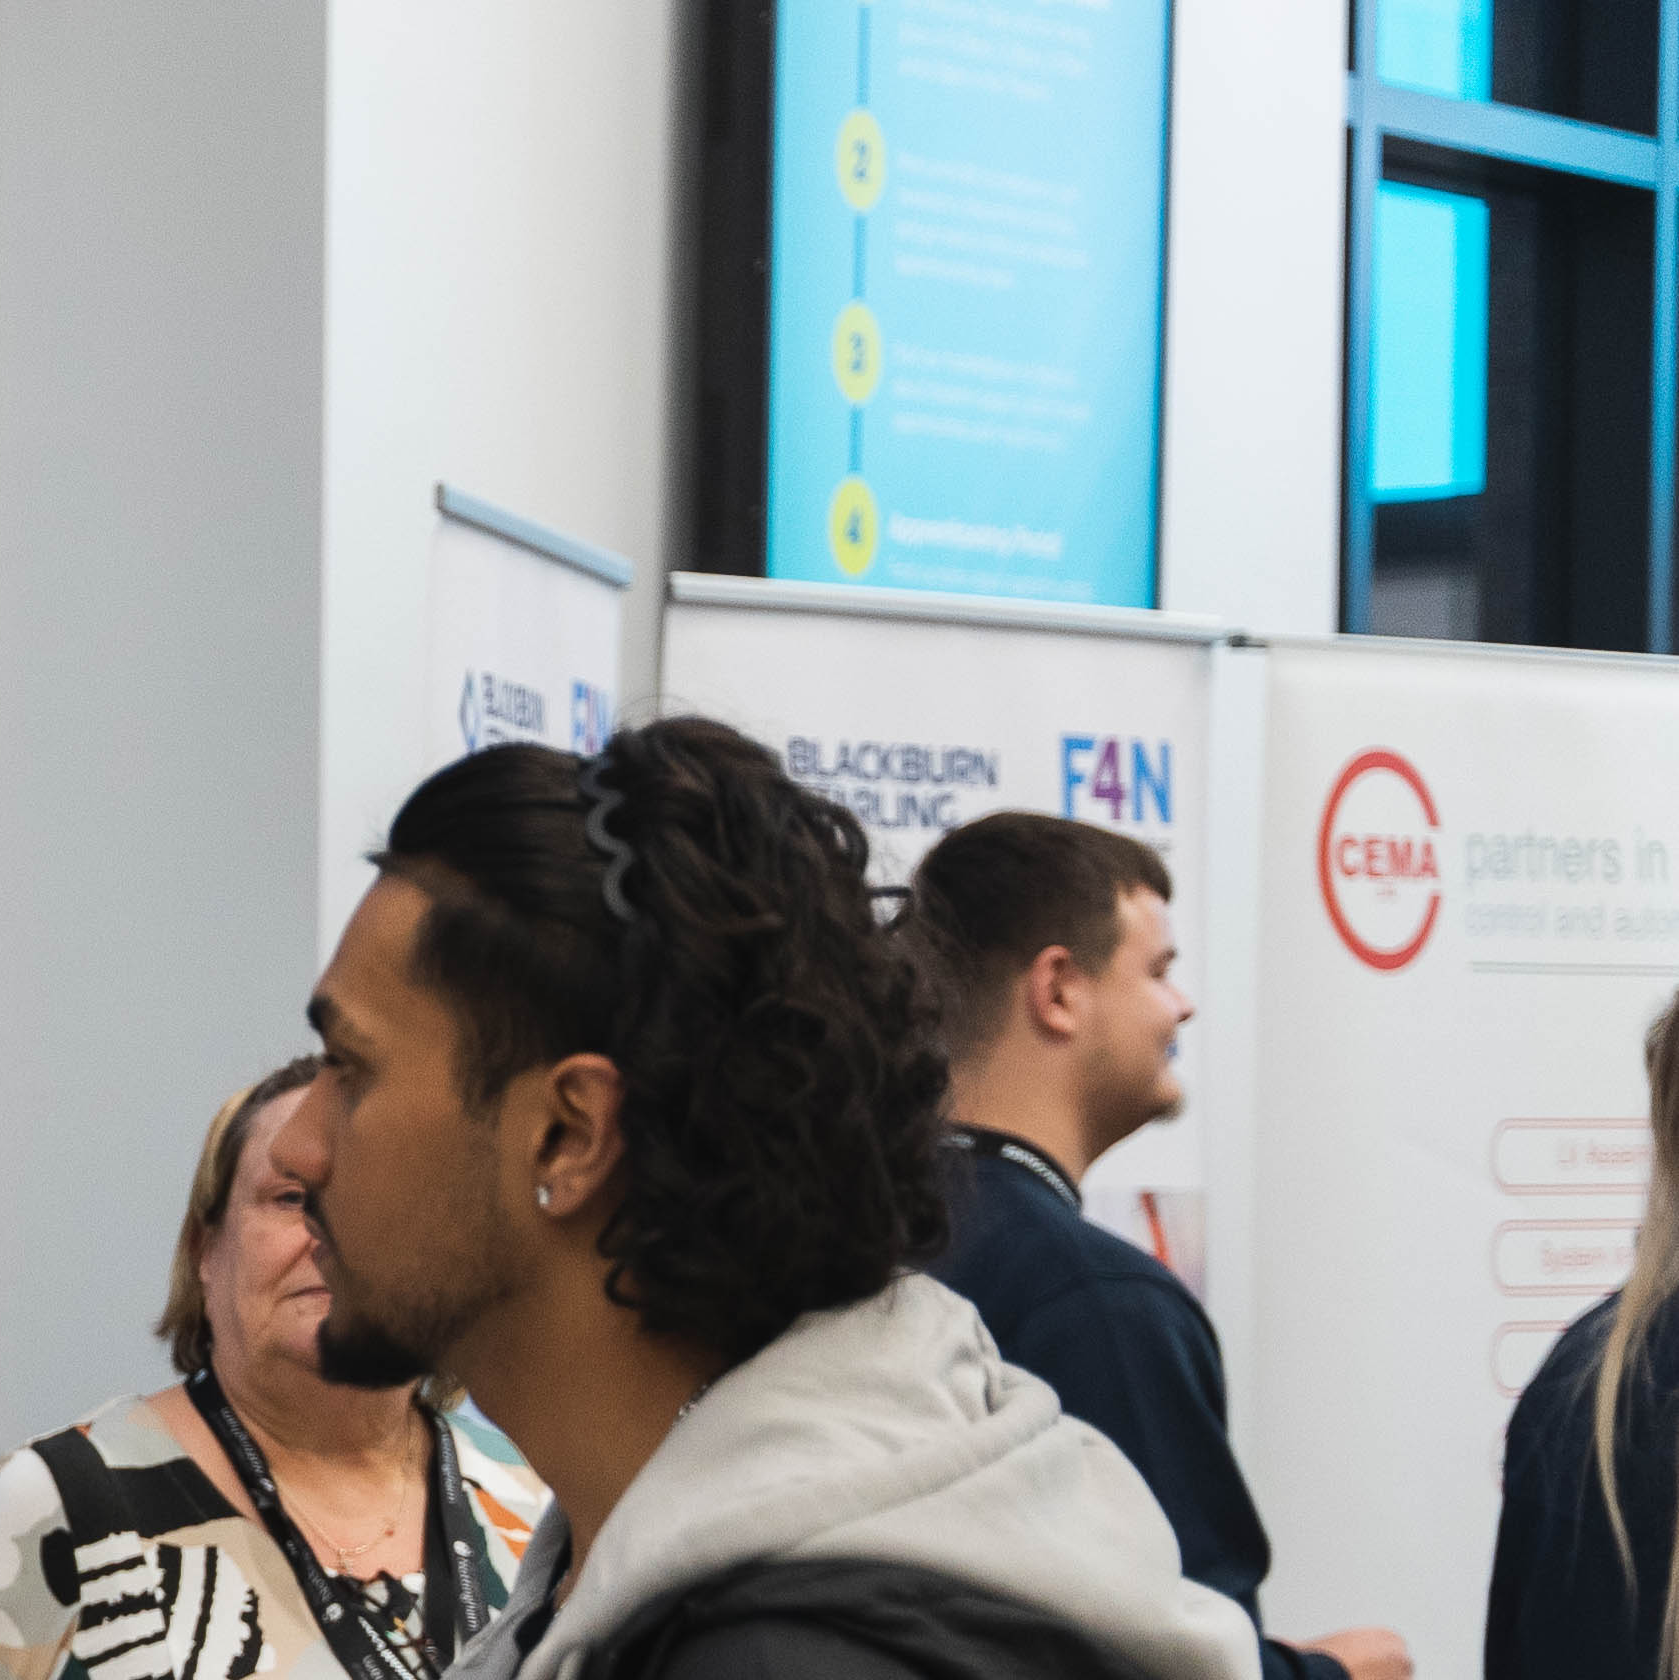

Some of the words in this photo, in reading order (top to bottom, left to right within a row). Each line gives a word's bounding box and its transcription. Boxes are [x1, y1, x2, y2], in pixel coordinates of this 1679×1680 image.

[787, 734, 998, 786] BLACKBURN
[1060, 731, 1173, 824] F4N
[1338, 834, 1439, 881] CEMA
[1465, 830, 1622, 893] partners
[1635, 825, 1671, 882] in
